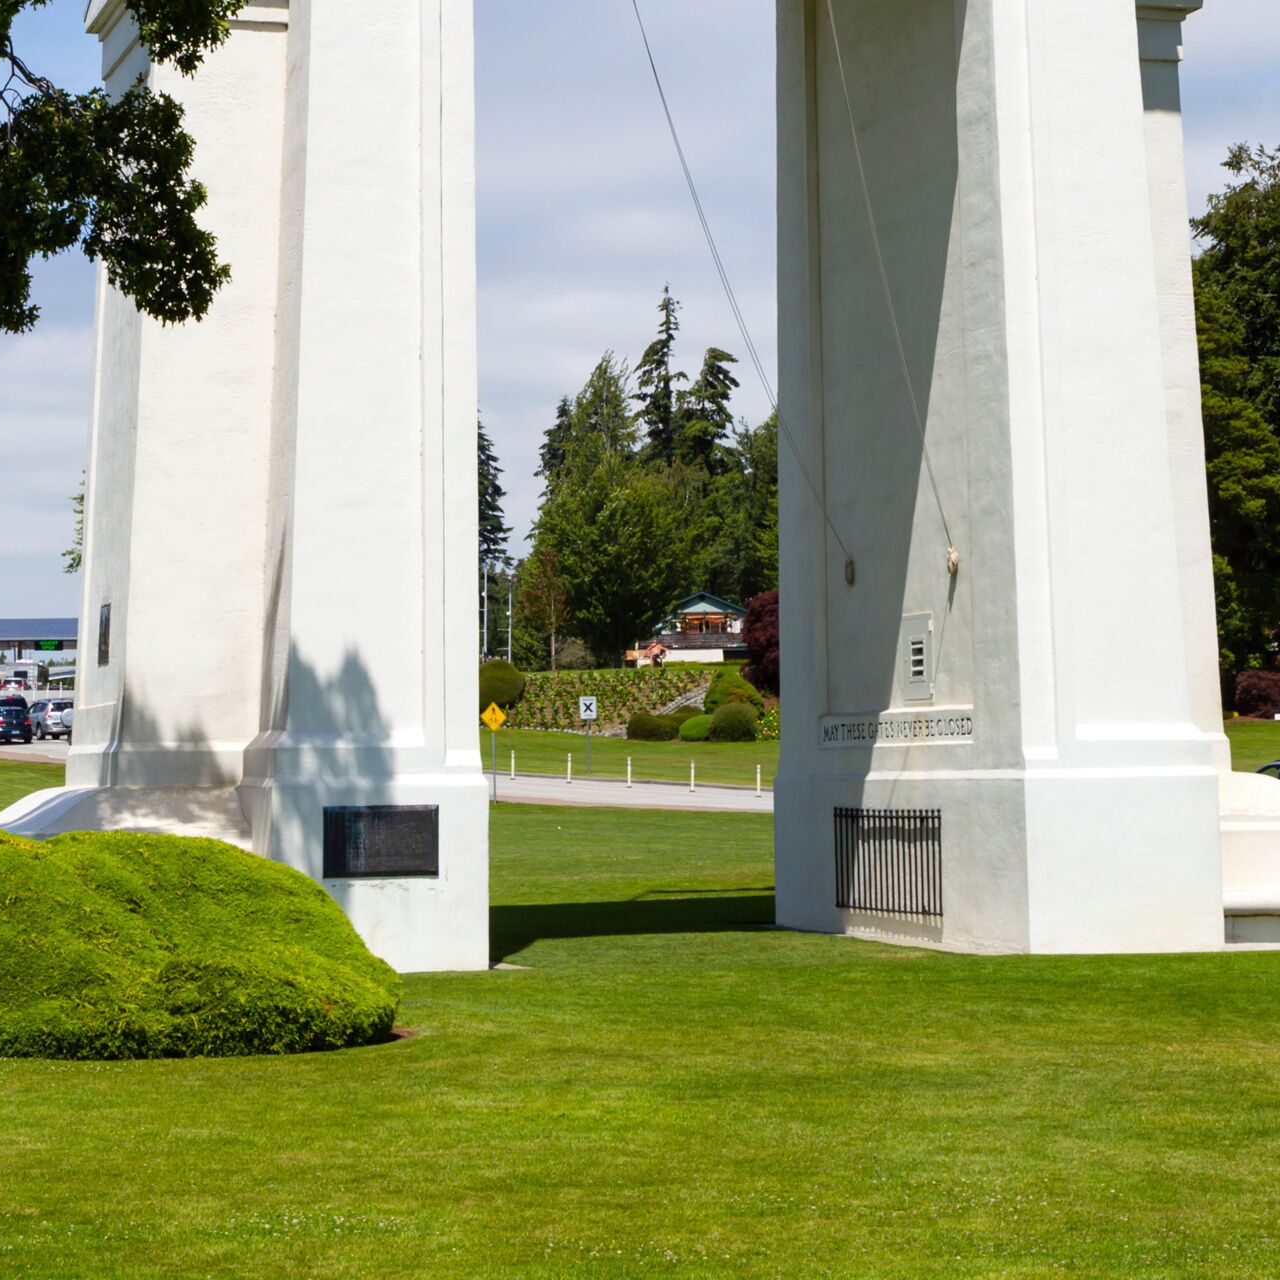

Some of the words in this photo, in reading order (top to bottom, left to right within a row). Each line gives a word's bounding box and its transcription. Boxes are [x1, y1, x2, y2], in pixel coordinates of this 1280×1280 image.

[824, 725, 840, 741] MAY
[841, 723, 865, 741] THESE
[868, 721, 894, 739] GATES
[897, 720, 922, 738] NEVER
[936, 717, 972, 736] CLOSED
